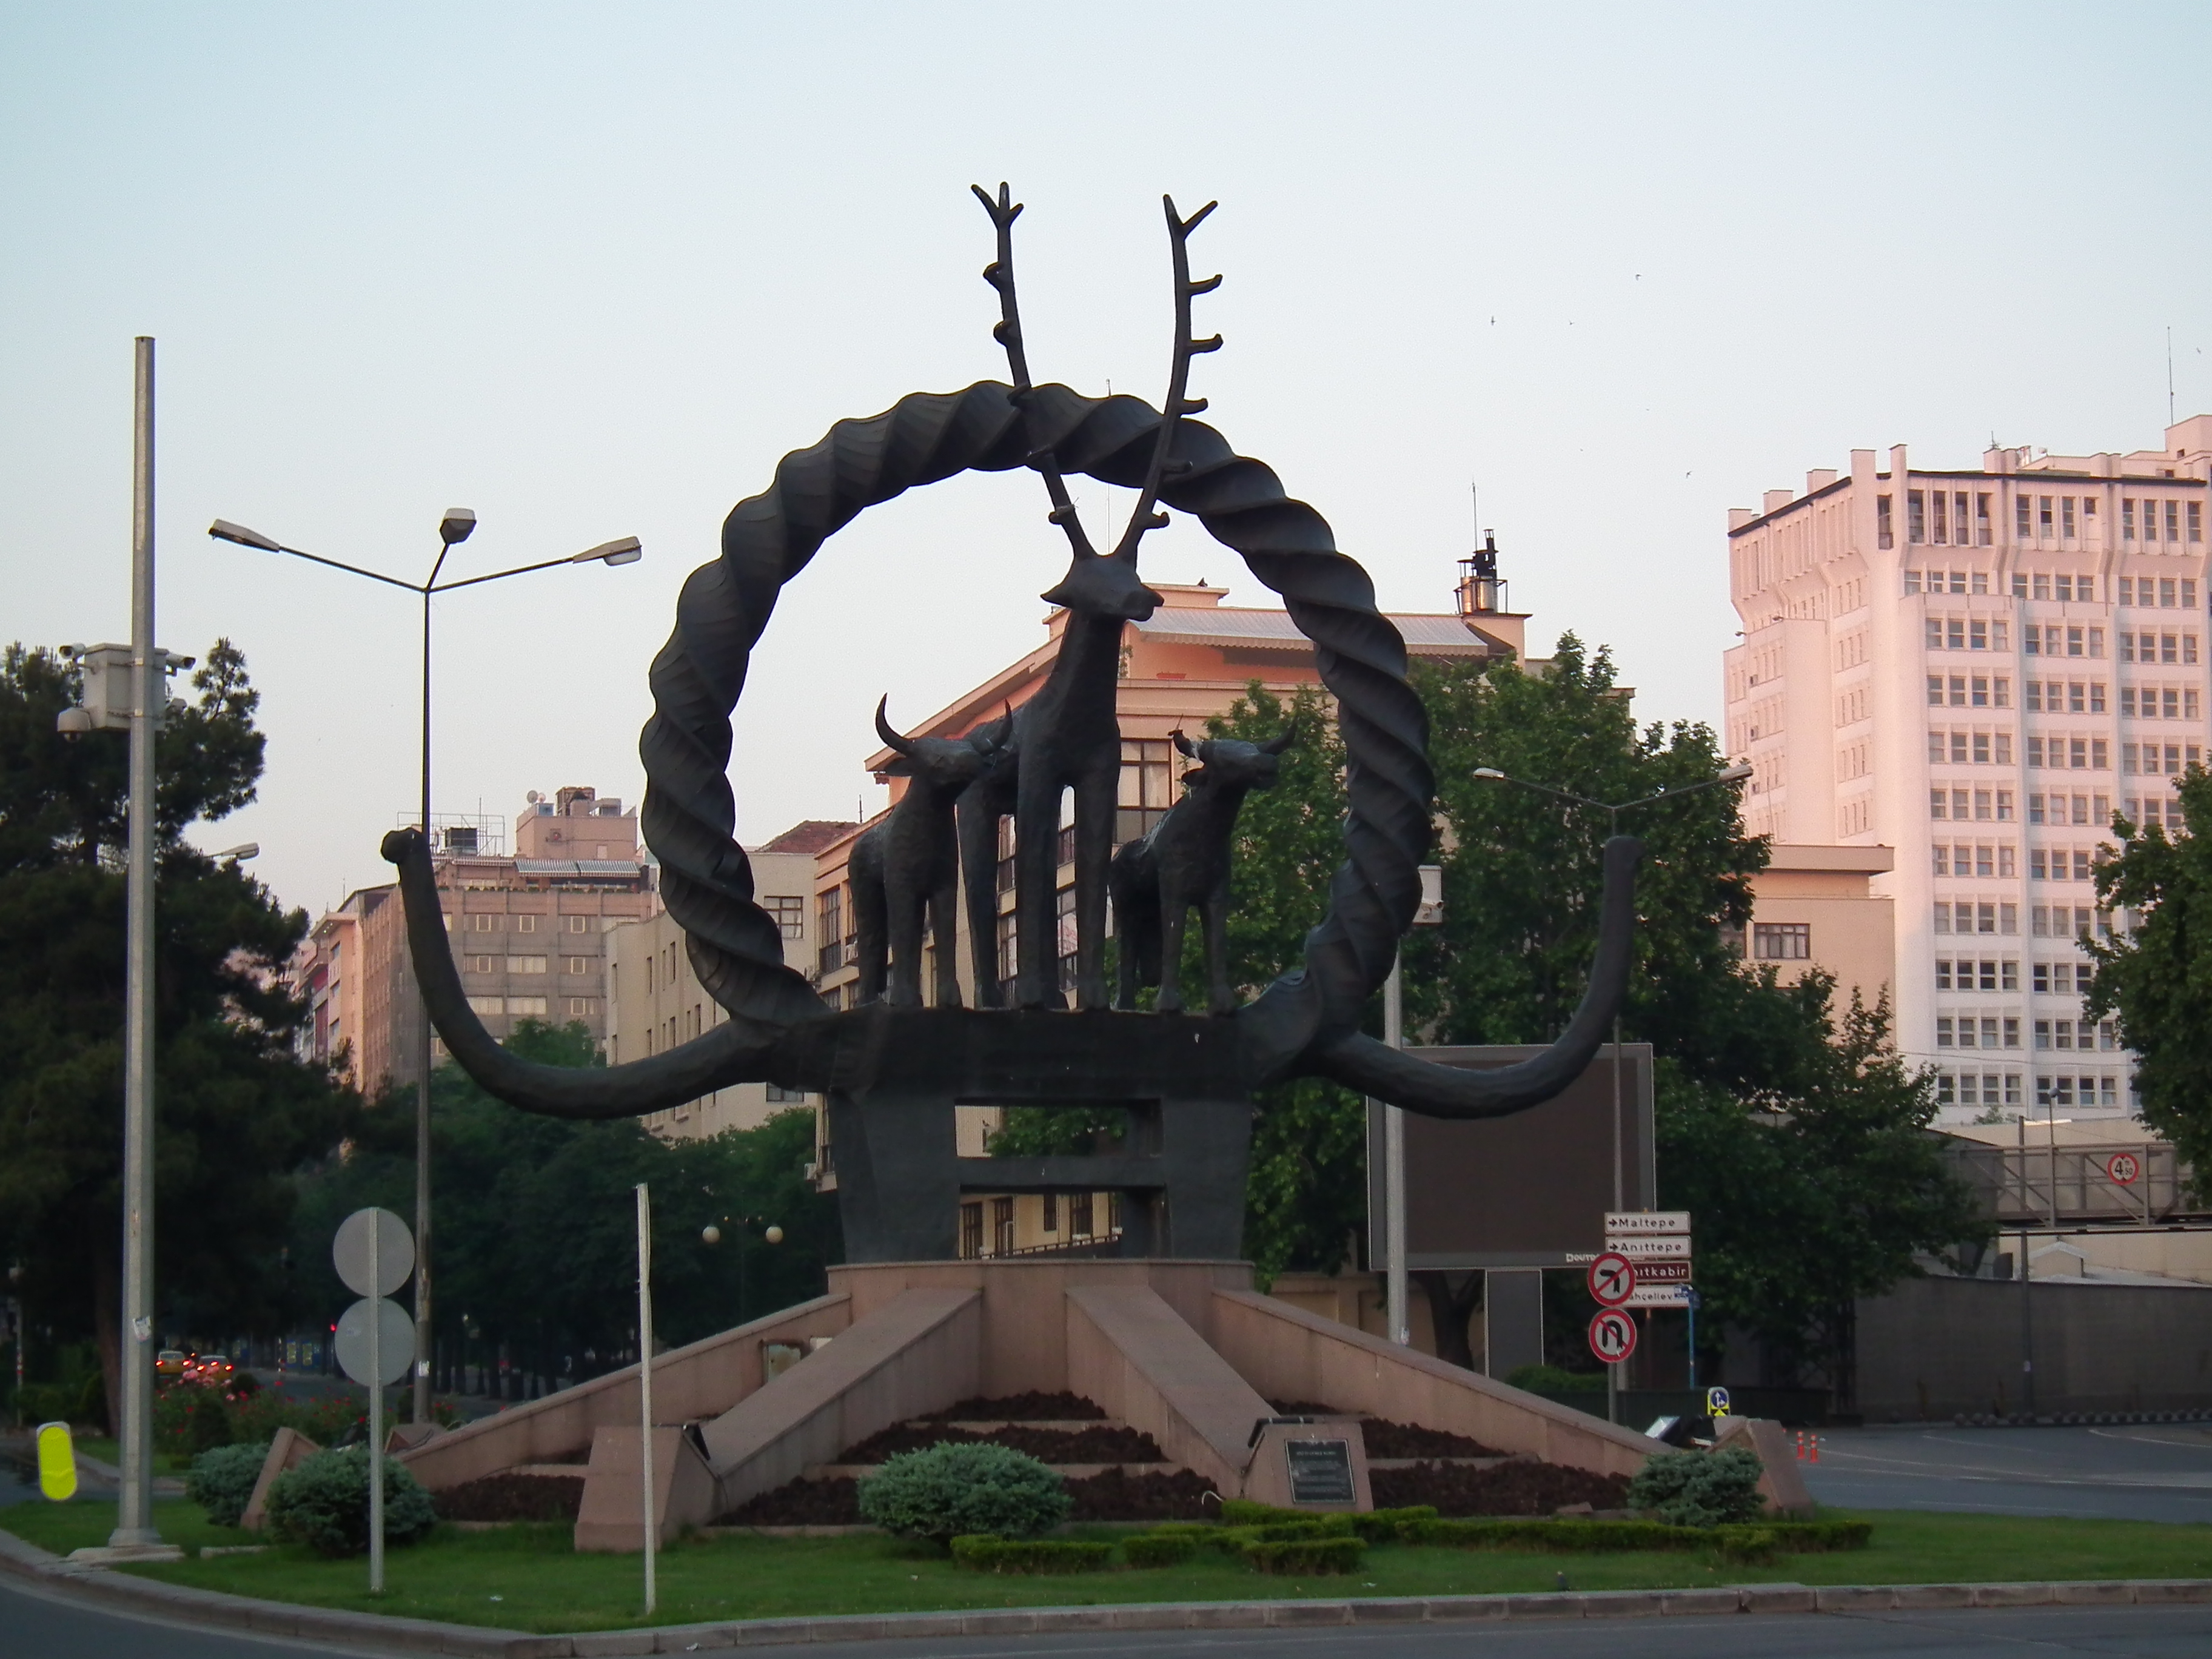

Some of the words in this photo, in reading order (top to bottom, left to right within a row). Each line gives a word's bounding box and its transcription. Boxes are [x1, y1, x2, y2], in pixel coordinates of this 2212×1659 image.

[2114, 1161, 2123, 1175] 4
[1619, 1218, 1675, 1229] Maltepe
[1634, 1266, 1686, 1276] nıtkabir
